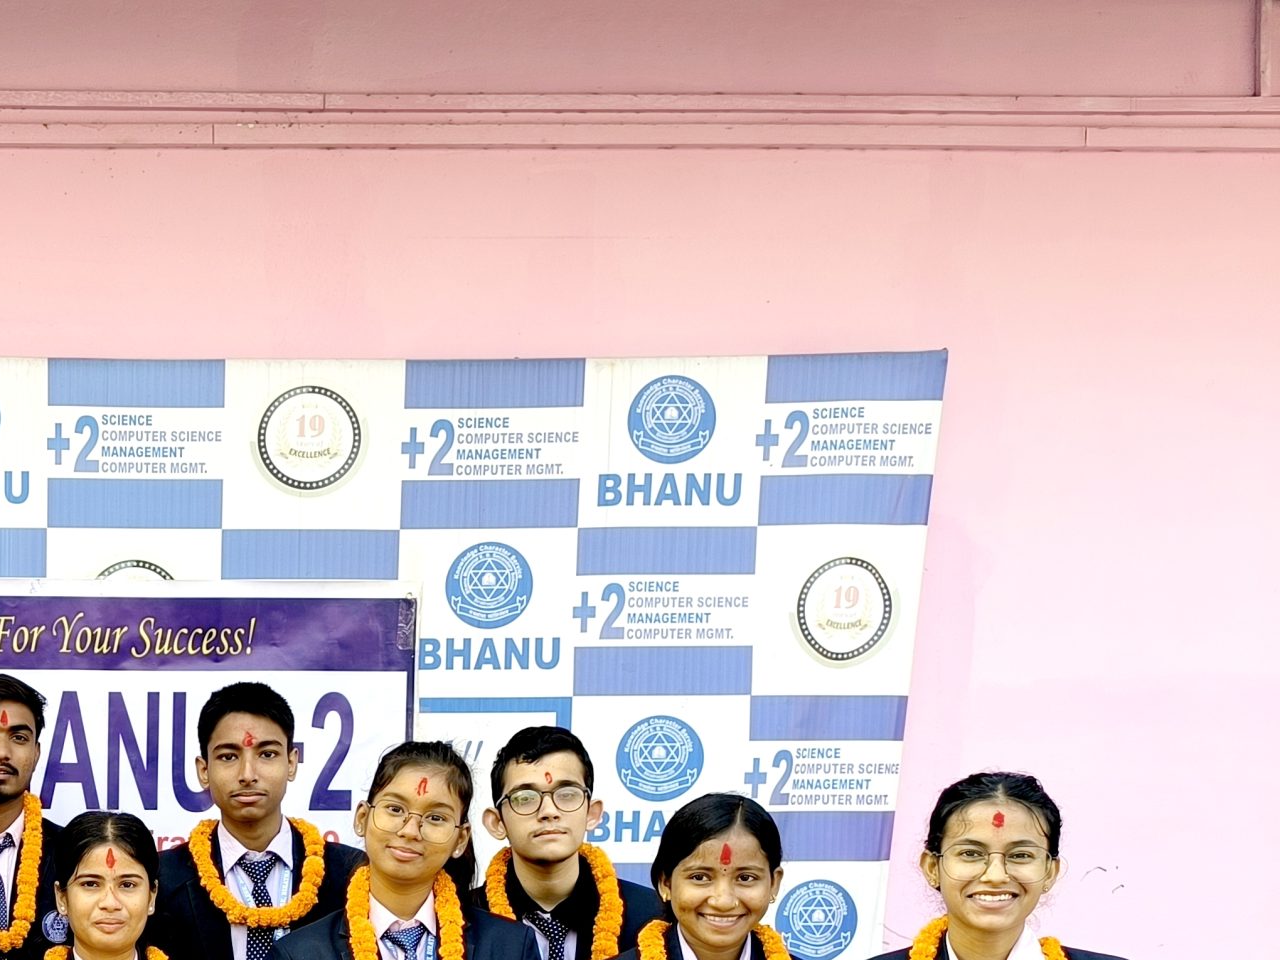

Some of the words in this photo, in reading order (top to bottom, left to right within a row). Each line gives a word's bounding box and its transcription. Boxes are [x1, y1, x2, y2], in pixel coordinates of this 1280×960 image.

[813, 407, 864, 419] SCIENCE
[101, 415, 152, 426] SCIENCE
[296, 414, 325, 437] 19
[458, 417, 509, 429] SCIENCE
[812, 423, 878, 435] COMPUTER
[882, 423, 932, 434] SCIENCE
[102, 431, 166, 442] COMPUTER
[171, 431, 222, 442] SCIENCE
[457, 433, 523, 444] COMPUTER
[527, 432, 579, 443] SCIENCE
[756, 411, 810, 468] +2
[47, 416, 99, 472] +2
[401, 419, 454, 476] +2
[811, 439, 895, 451] MANAGEMENT
[101, 446, 184, 458] MANAGEMENT
[289, 448, 331, 458] EXCELLENCE
[456, 448, 541, 460] MANAGEMENT
[810, 455, 876, 467] COMPUTER
[880, 456, 914, 467] MGMT.
[101, 462, 166, 473] COMPUTER
[171, 463, 207, 474] MGMT.
[456, 464, 522, 476] COMPUTER
[526, 464, 564, 475] MGMT.
[597, 473, 742, 507] BHANU
[629, 581, 679, 592] SCIENCE
[628, 597, 693, 608] COMPUTER
[697, 597, 749, 608] SCIENCE
[834, 585, 859, 608] 19
[573, 583, 626, 639] +2
[628, 613, 710, 624] MANAGEMENT
[826, 619, 862, 630] EXCELLENCE
[52, 612, 128, 655] Your
[131, 617, 256, 658] Success!
[627, 628, 691, 640] COMPUTER
[696, 628, 734, 639] MGMT.
[419, 638, 560, 670] BHANU
[795, 748, 840, 759] SCIENCE
[794, 764, 854, 774] COMPUTER
[858, 764, 898, 775] SCIENCE
[744, 750, 793, 805] +2
[792, 779, 871, 790] MANAGEMENT
[790, 794, 852, 805] COMPUTER
[856, 794, 889, 806] MGMT.
[587, 810, 667, 842] BHA
